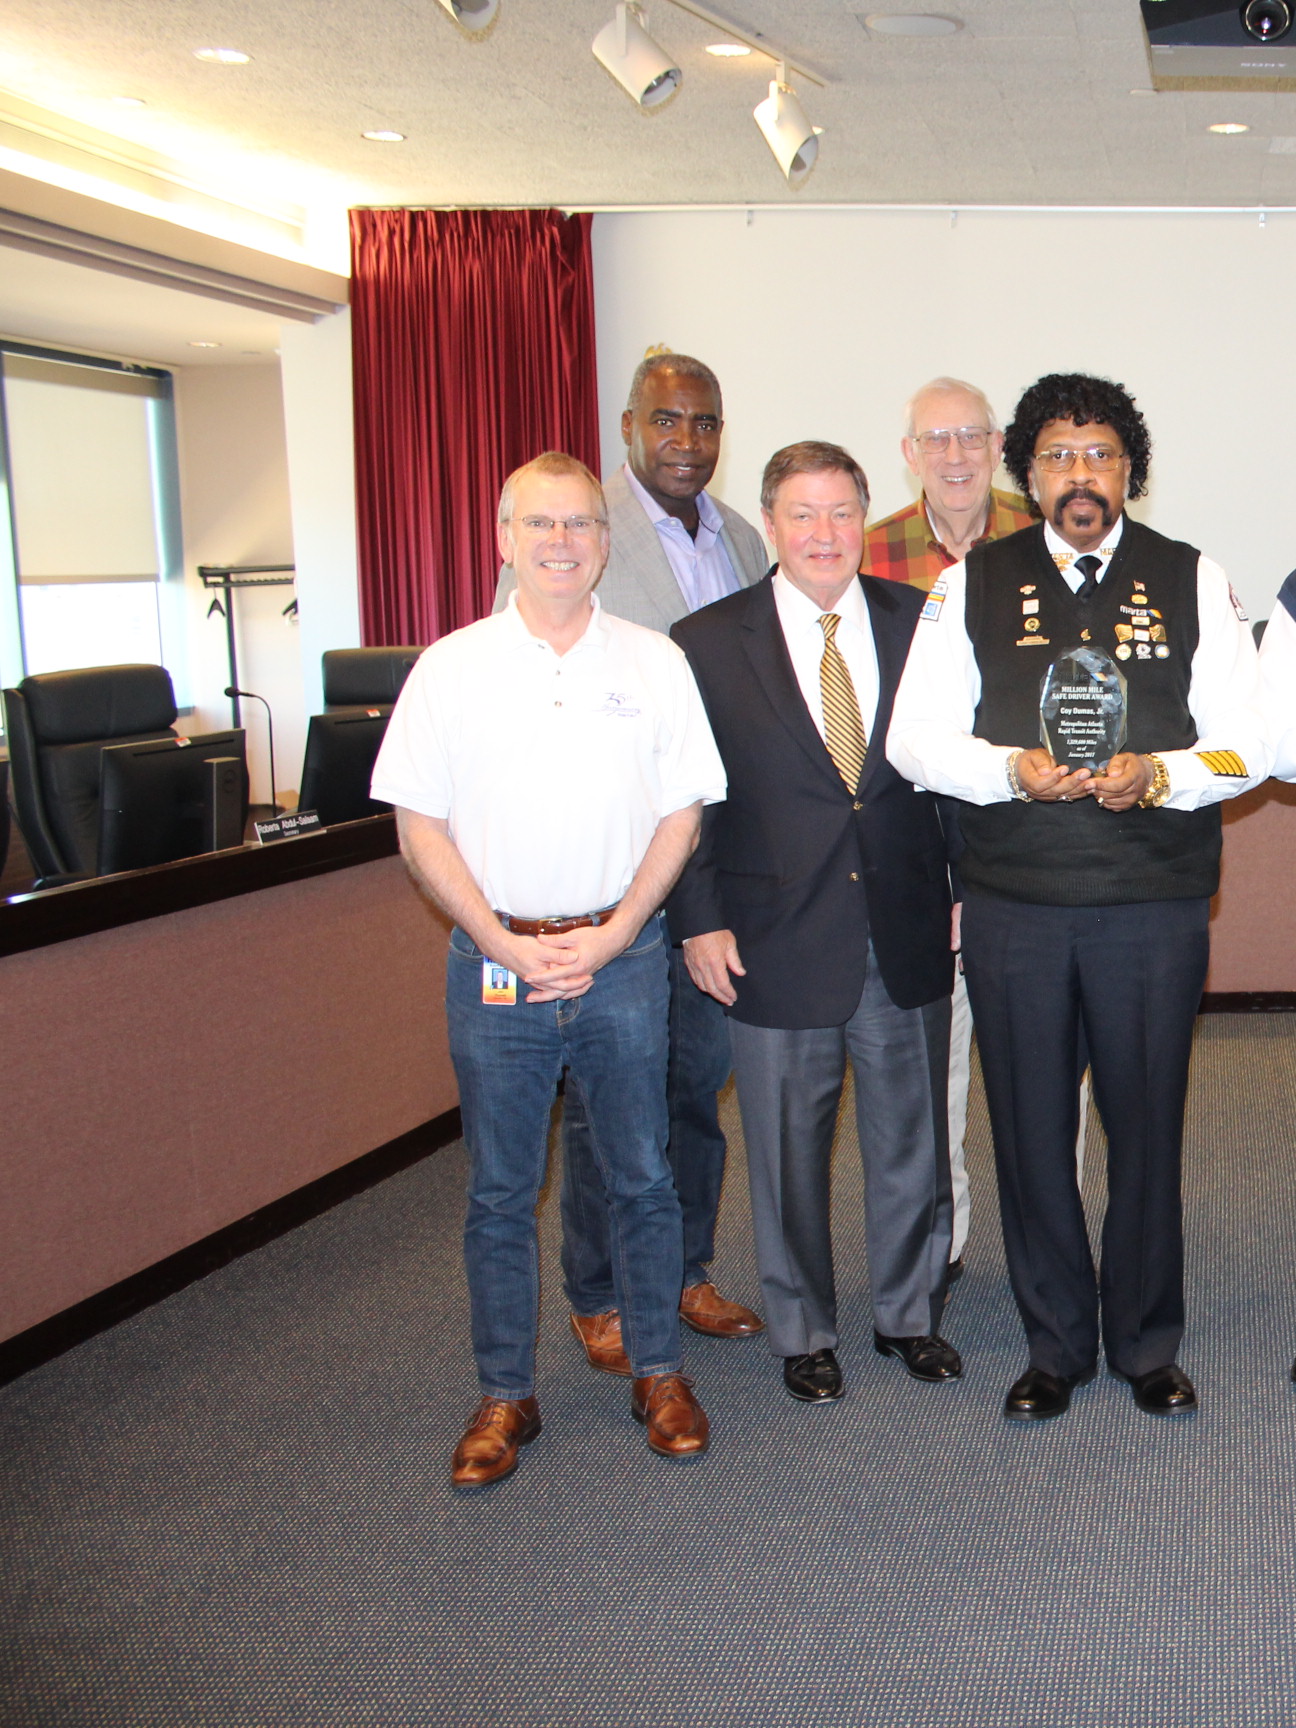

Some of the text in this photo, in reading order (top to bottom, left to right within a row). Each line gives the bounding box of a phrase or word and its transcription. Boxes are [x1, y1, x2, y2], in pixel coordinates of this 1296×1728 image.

[1120, 604, 1147, 617] marta
[1060, 707, 1072, 715] Coy
[1060, 720, 1087, 728] Metropolitan
[258, 823, 280, 834] Roberta
